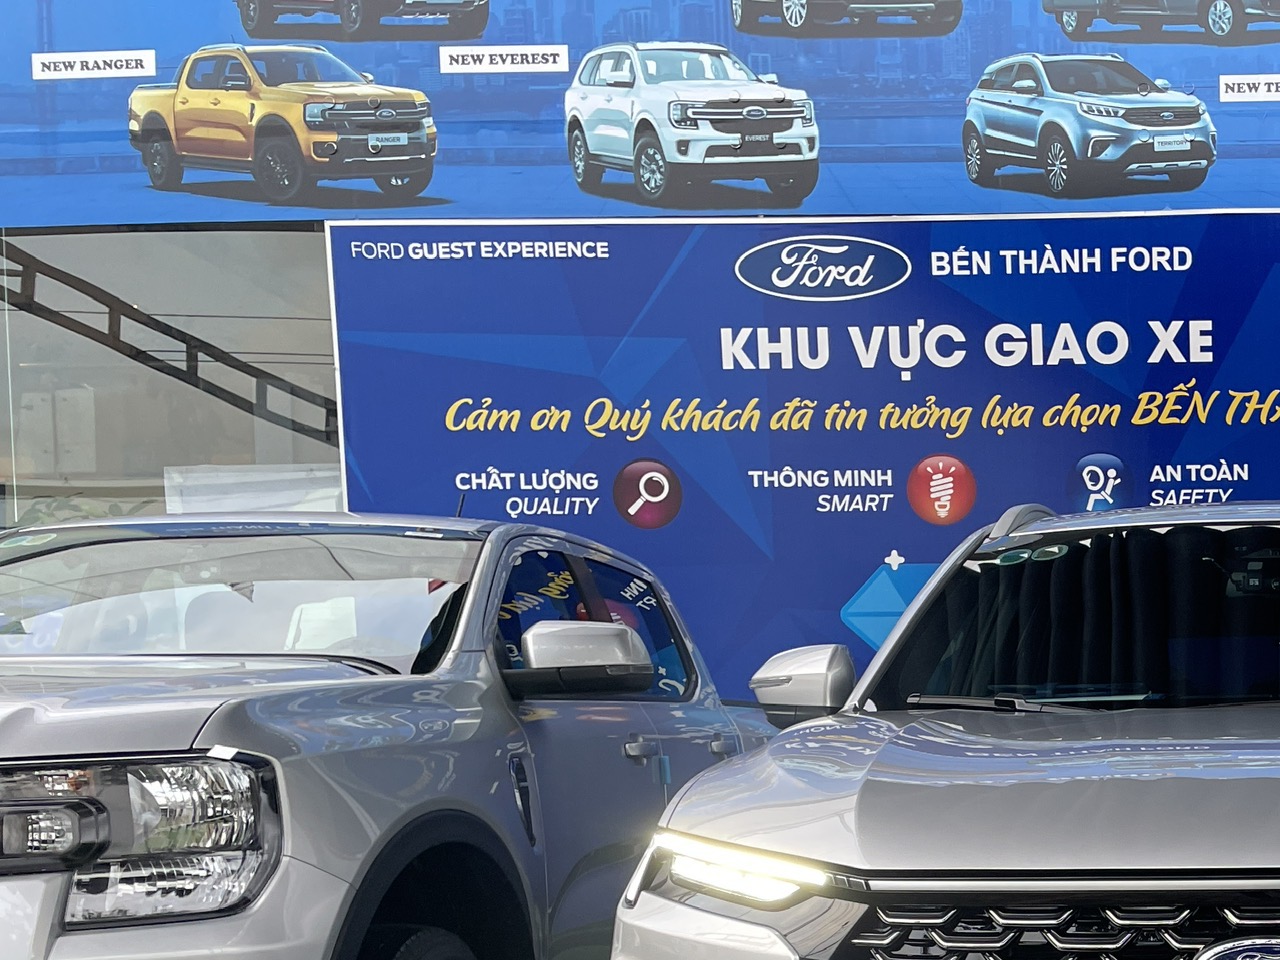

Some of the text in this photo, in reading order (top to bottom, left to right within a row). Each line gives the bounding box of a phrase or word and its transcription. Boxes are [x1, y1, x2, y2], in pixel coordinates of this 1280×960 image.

[40, 59, 145, 72] NEW RANGER
[448, 53, 560, 65] NEW EVEREST
[1224, 82, 1261, 93] NEW
[351, 241, 609, 259] FORD GUEST EXPERIENCE
[931, 243, 1193, 276] BẾN THÀNH FORD
[771, 243, 875, 288] Ford
[720, 318, 1214, 381] KHU VỰC GIAO XE
[445, 397, 521, 432] Cảm
[530, 406, 571, 432] ơn
[584, 398, 651, 441] Quý
[661, 398, 761, 432] khách
[769, 397, 818, 431] đã
[824, 400, 868, 431] tin
[879, 396, 973, 439] tưởng
[981, 394, 1034, 436] lựa
[1042, 393, 1122, 434] chọn
[1130, 378, 1221, 426] BẾN
[455, 466, 599, 494] CHẤT LƯỢNG
[747, 466, 893, 488] THÔNG MINH
[1150, 458, 1249, 482] AN TOÀN
[505, 497, 600, 518] QUALITY
[816, 494, 895, 512] SMART
